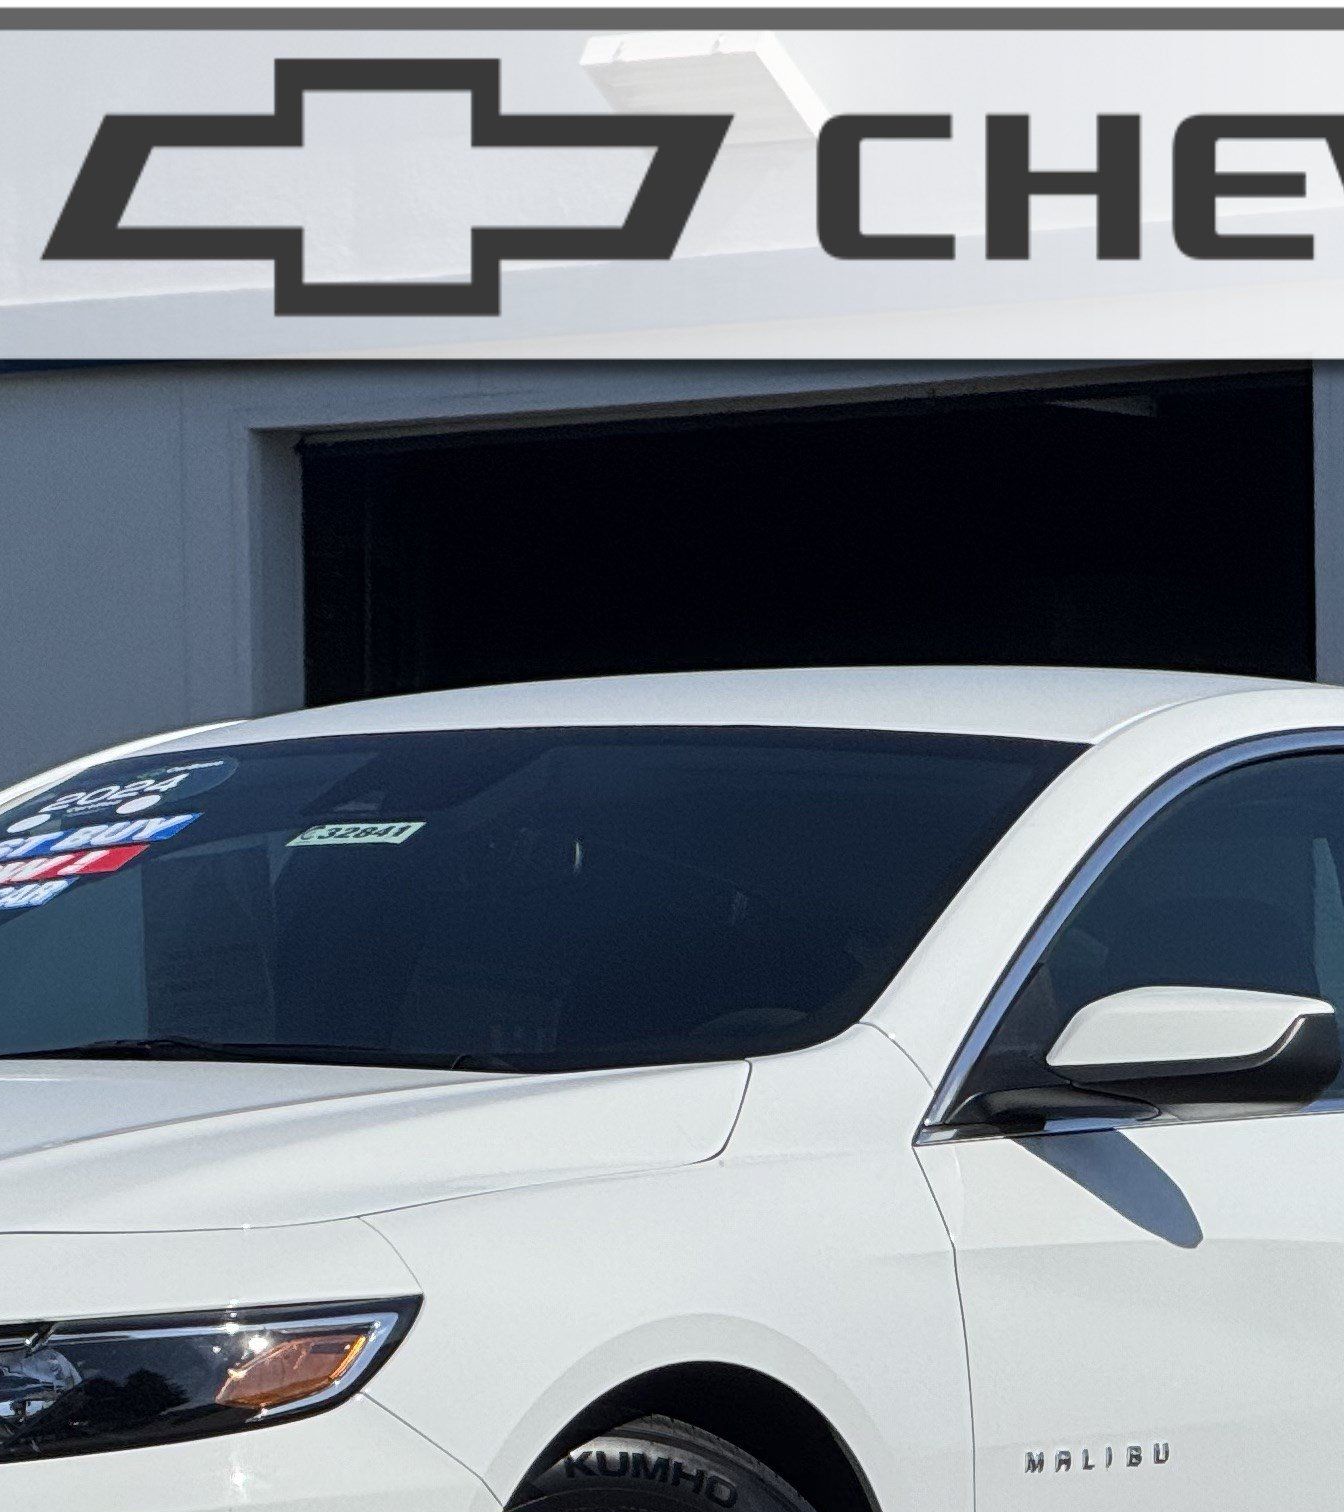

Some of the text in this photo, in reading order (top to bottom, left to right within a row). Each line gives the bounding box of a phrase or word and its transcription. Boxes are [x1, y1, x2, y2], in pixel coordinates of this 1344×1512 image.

[39, 772, 191, 813] 2024
[50, 813, 197, 852] BUY
[1024, 1442, 1170, 1474] MALIBU
[563, 1449, 740, 1511] KUMHO
